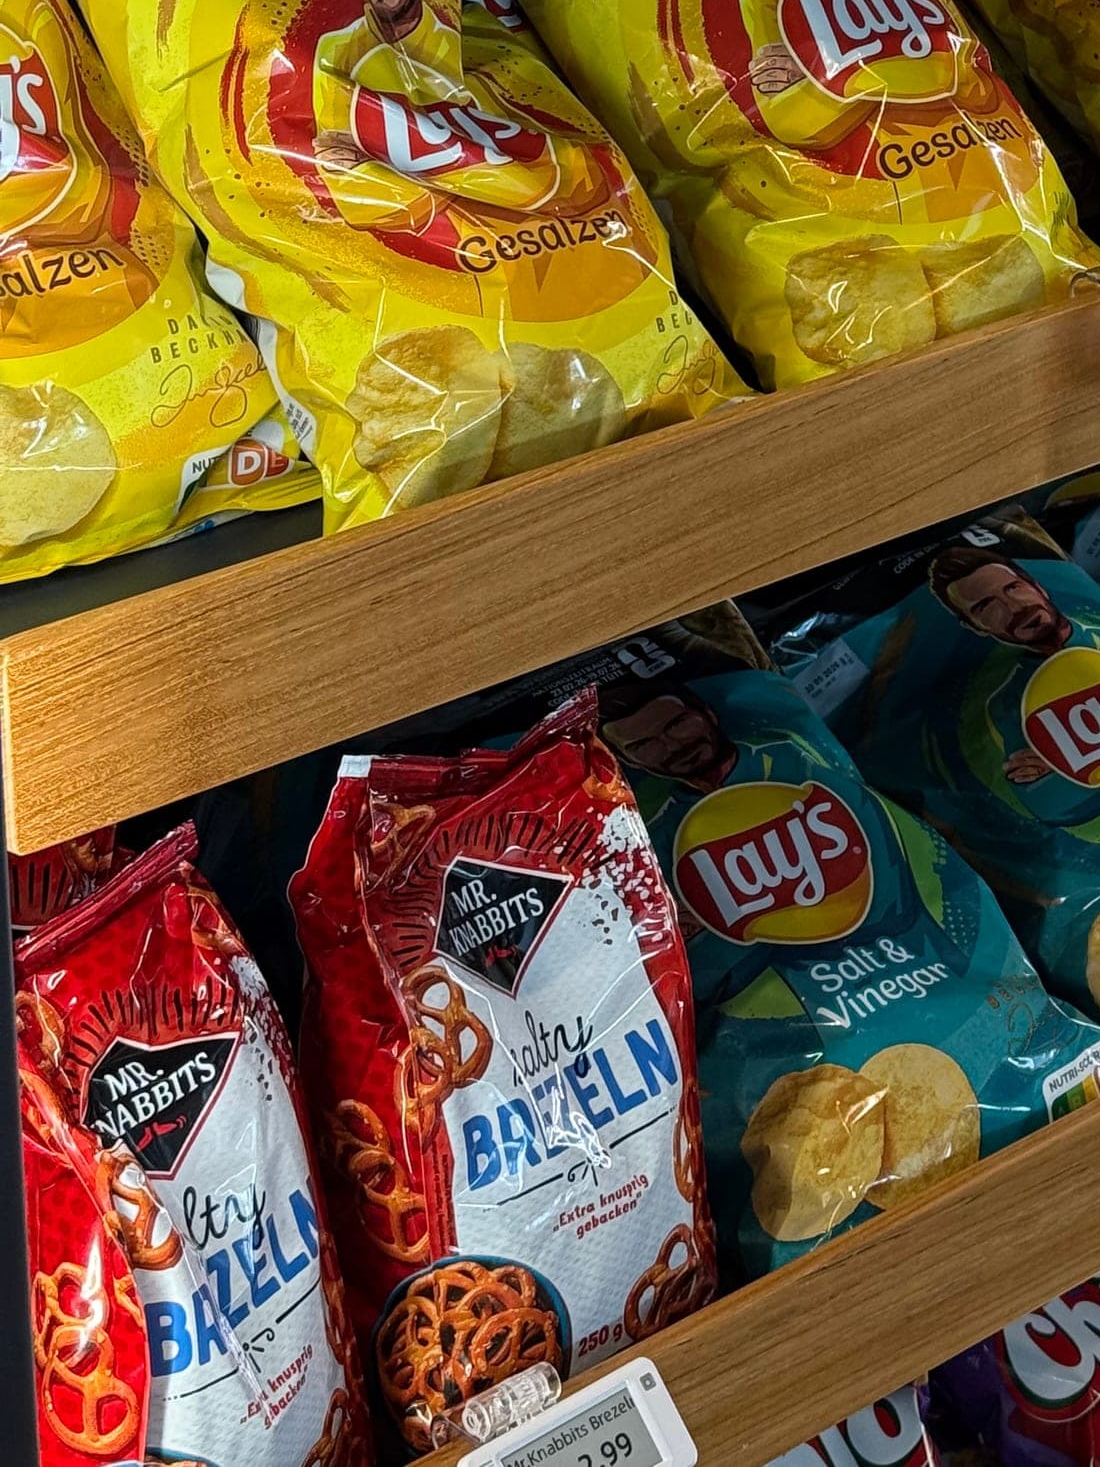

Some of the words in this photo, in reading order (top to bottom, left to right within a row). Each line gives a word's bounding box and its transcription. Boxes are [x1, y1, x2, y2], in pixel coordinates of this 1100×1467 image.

[876, 116, 1020, 182] Gesalzen
[457, 205, 628, 275] Gesalzen
[693, 798, 849, 927] Lay's
[447, 887, 544, 957] KNABBITS
[451, 877, 498, 916] MR.
[810, 948, 875, 995] Salt
[879, 937, 914, 965] &
[816, 961, 950, 1030] Vinegar
[91, 1050, 216, 1140] NABBITS
[103, 1061, 164, 1102] MR.
[599, 1174, 650, 1209] knusprig
[578, 1322, 611, 1359] 250
